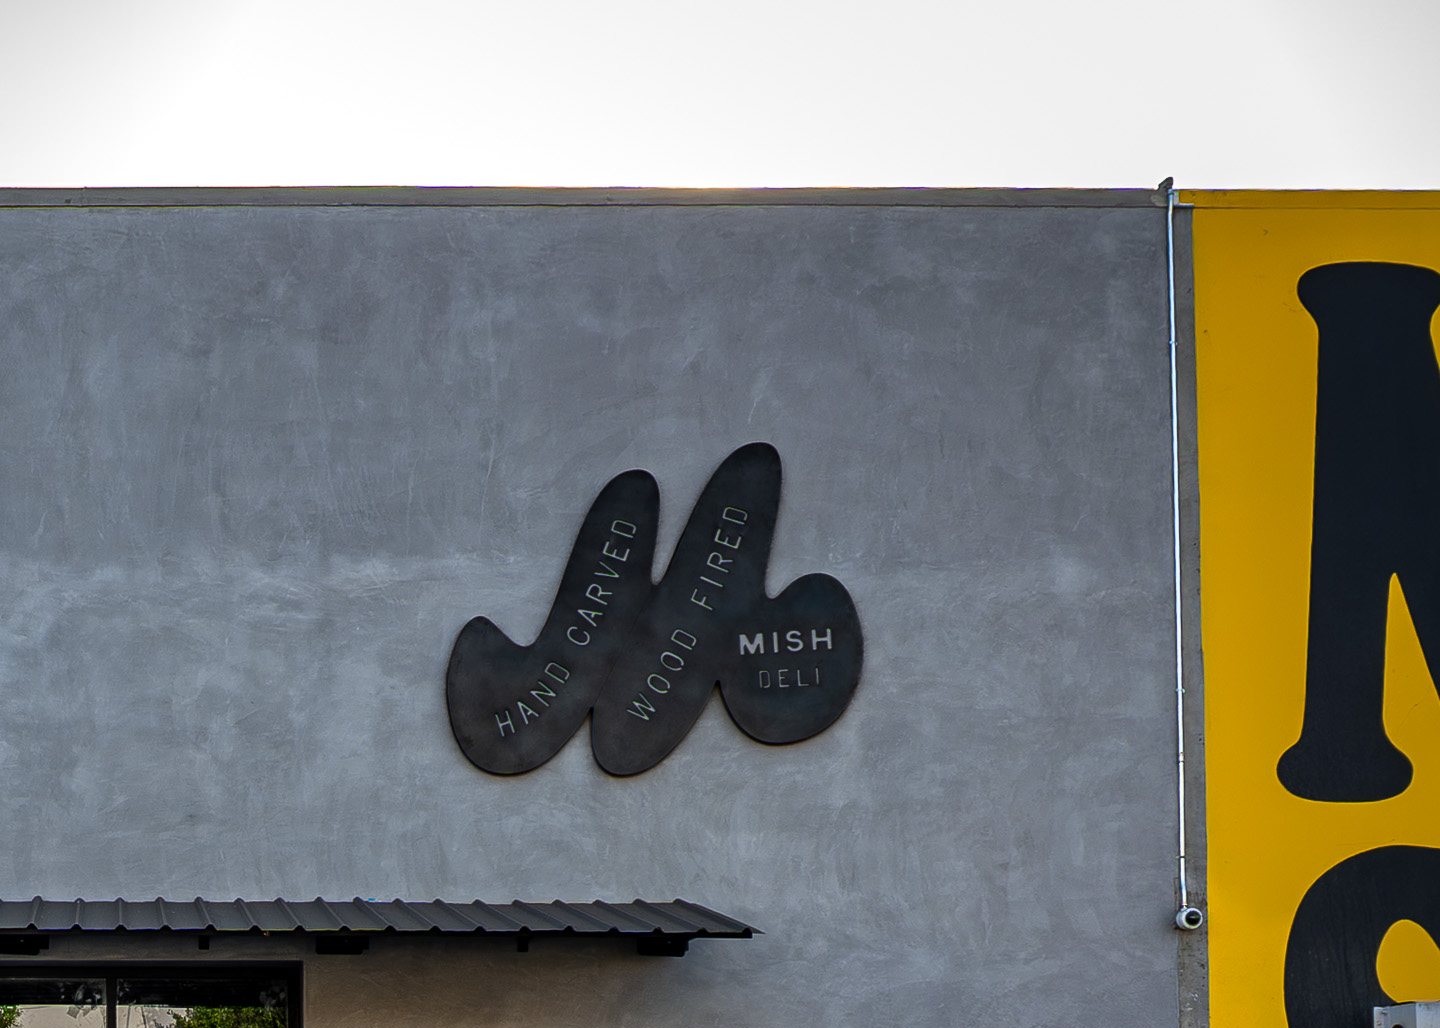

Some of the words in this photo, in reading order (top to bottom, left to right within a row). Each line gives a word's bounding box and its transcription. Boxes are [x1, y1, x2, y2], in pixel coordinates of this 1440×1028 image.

[494, 662, 570, 737] HAND
[566, 519, 637, 646] CARVED
[626, 629, 697, 721] WOOD
[690, 506, 748, 611] FIRED
[739, 628, 833, 655] MISH
[759, 667, 820, 688] DELI
